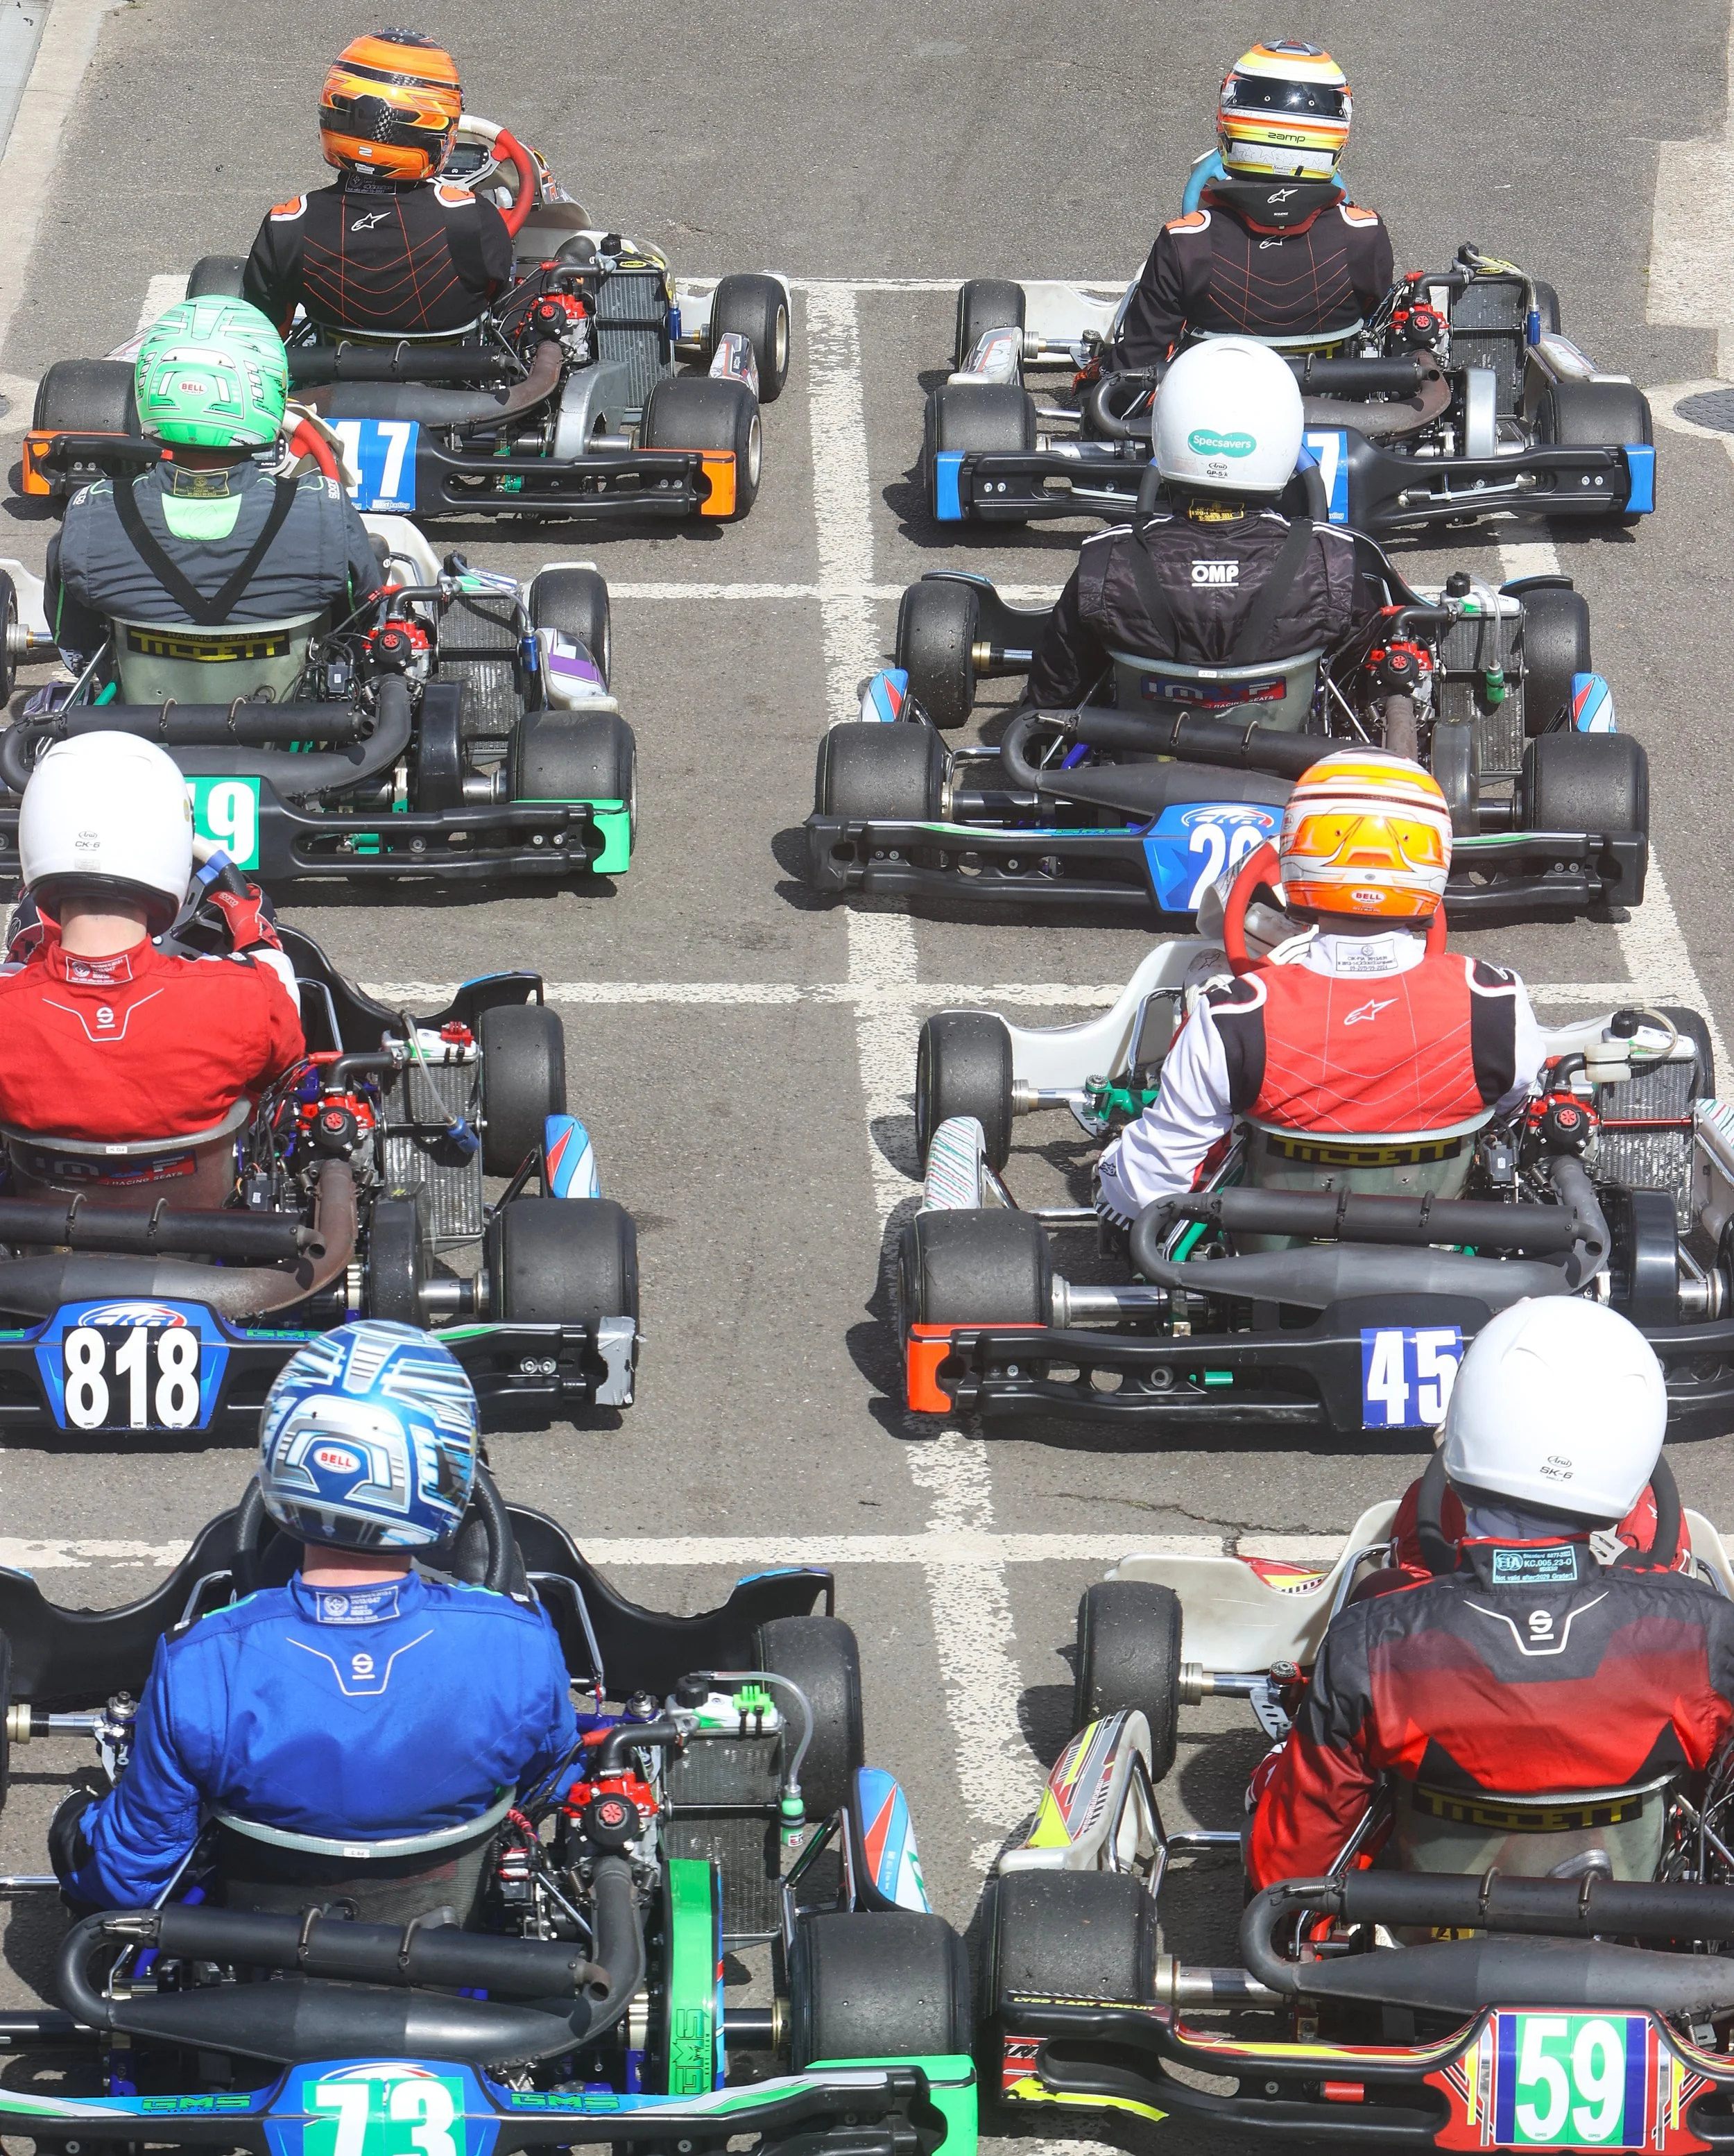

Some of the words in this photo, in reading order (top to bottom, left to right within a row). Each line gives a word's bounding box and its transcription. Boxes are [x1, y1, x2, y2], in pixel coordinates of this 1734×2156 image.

[1267, 132, 1305, 144] zamp
[182, 383, 205, 392] BELL
[1193, 434, 1252, 450] Specsavers
[1192, 565, 1239, 583] OMP
[168, 632, 212, 642] RACING
[221, 633, 260, 642] SEATS
[1214, 700, 1246, 709] RACING
[219, 892, 239, 907] sparco
[65, 1327, 200, 1429] 818
[1367, 1330, 1459, 1424] 45
[321, 1453, 352, 1467] BELL
[1539, 1466, 1574, 1479] SK-6
[1498, 1557, 1521, 1568] FIA
[1100, 2003, 1156, 2011] CIRCUIT
[1516, 2018, 1625, 2142] 59
[142, 2094, 251, 2110] GMS
[510, 2093, 620, 2110] GMS
[316, 2080, 458, 2156] 73
